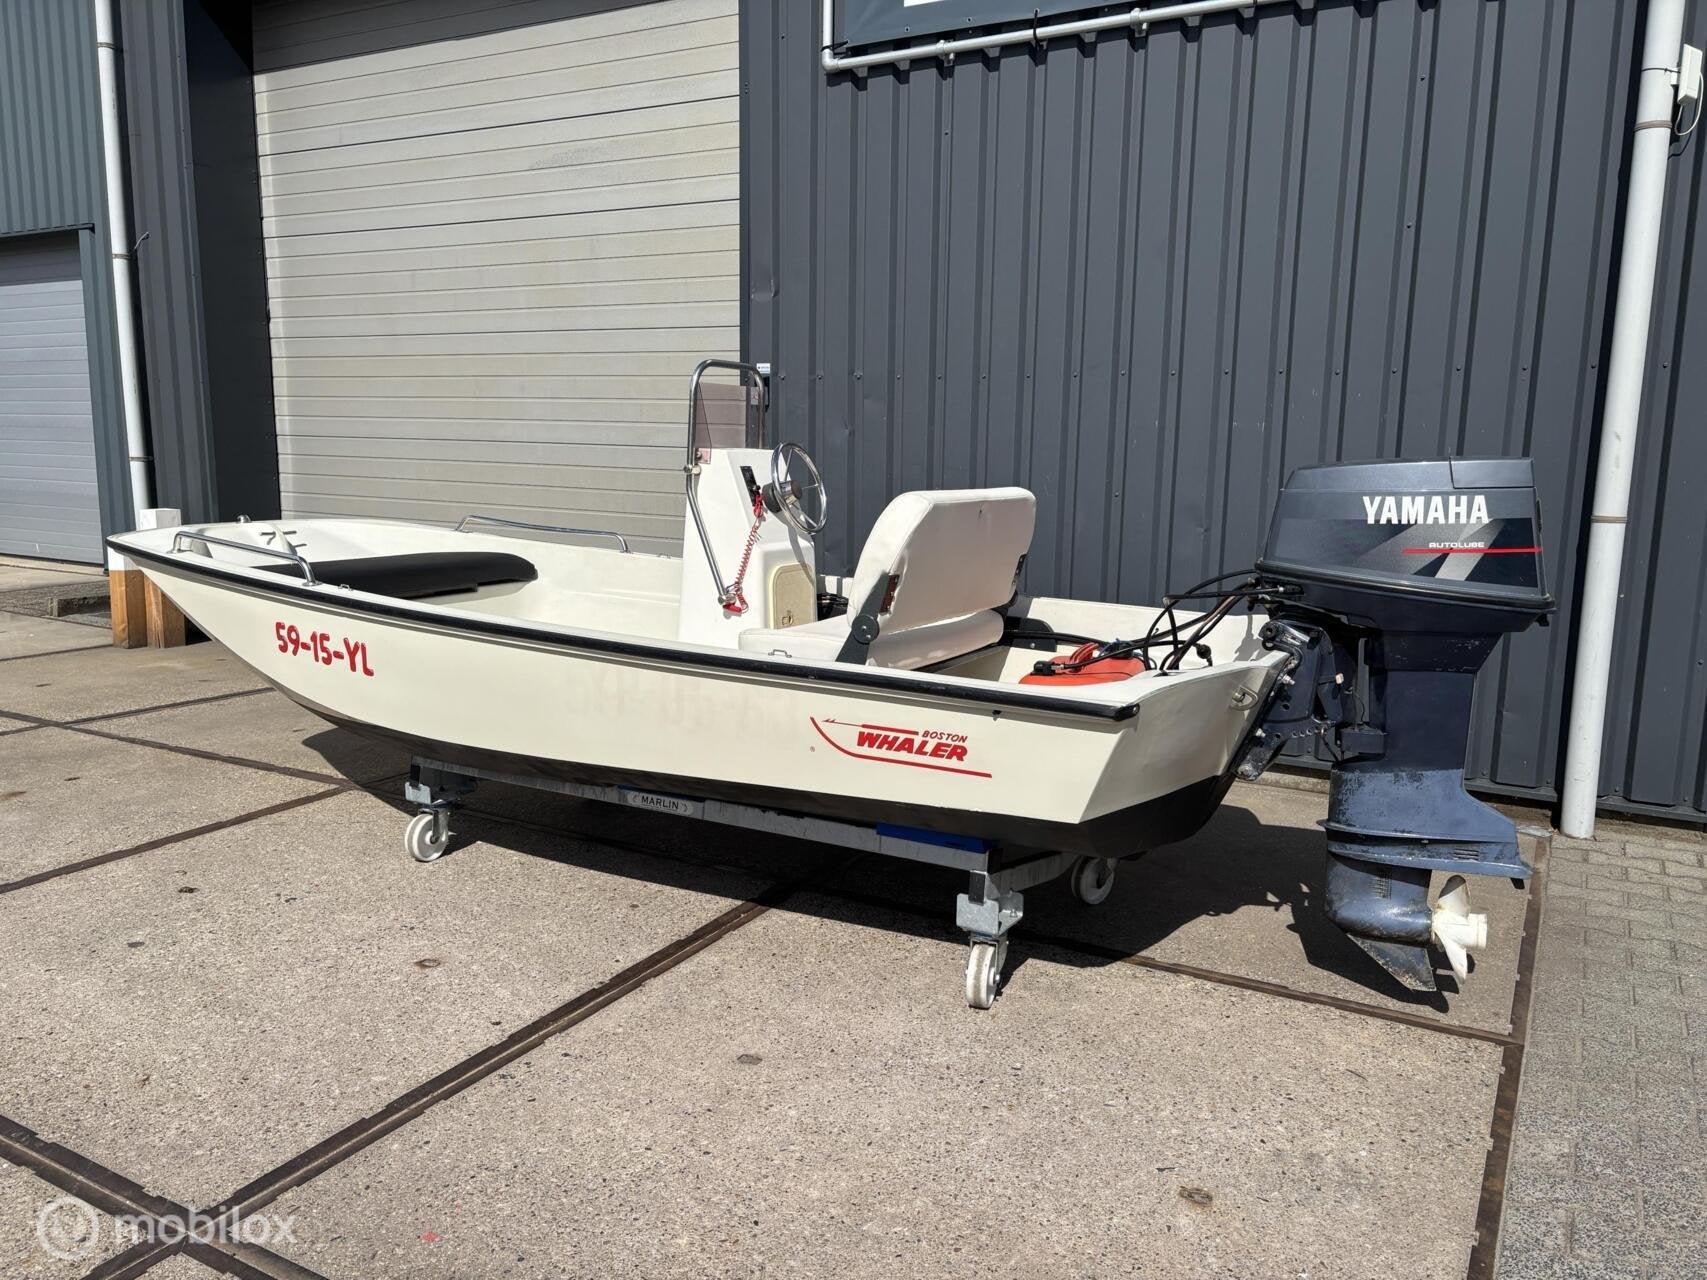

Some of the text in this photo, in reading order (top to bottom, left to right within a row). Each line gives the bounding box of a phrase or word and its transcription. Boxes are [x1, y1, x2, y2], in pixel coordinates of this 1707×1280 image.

[1362, 495, 1490, 525] YAMAHA
[275, 621, 375, 677] 59-15-YL
[856, 731, 968, 762] WHALER
[921, 730, 968, 743] BOSTON
[641, 795, 679, 810] MARLIN
